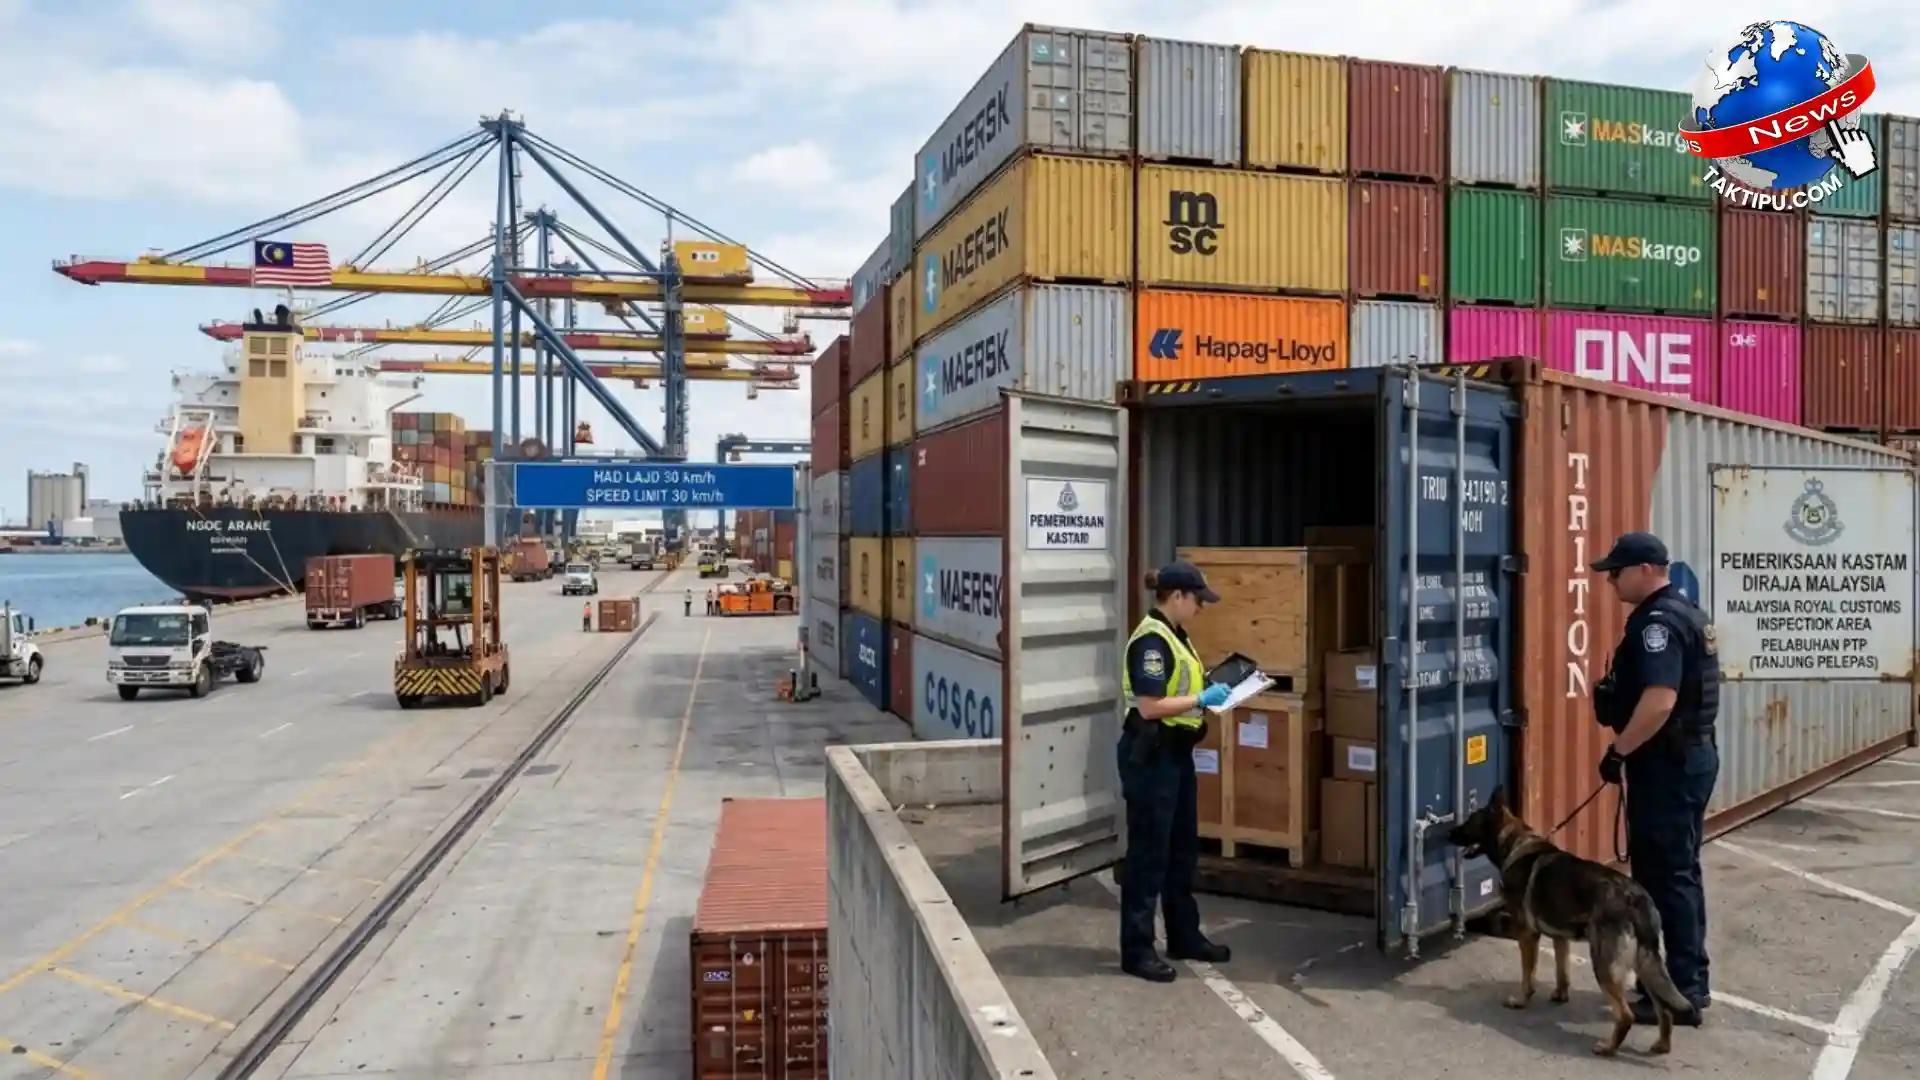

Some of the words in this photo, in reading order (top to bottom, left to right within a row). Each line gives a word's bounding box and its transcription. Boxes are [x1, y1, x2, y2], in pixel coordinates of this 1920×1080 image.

[941, 81, 1010, 182] MAERSK
[1592, 117, 1688, 153] MASkarg
[942, 206, 1009, 291] MAERSK
[1592, 234, 1701, 266] MASkargo
[942, 328, 1009, 398] MAERSK
[1196, 335, 1336, 363] Hapag-Lloyd
[1575, 328, 1692, 385] ONE
[585, 488, 631, 503] SPEED
[671, 489, 688, 503] 30
[1030, 513, 1105, 529] PEMERIKSAAN
[1720, 552, 1837, 570] PEMERIKSAAN
[1841, 553, 1908, 570] KASTAM
[1566, 453, 1590, 698] TRITON
[1743, 574, 1802, 592] DIRAJA
[1805, 575, 1886, 592] MALAYSIA
[1726, 600, 1791, 614] MALAYSIA
[1793, 600, 1836, 614] ROYAL
[1839, 600, 1902, 614] CUSTOMS
[1835, 617, 1873, 632] AREA
[1761, 637, 1841, 652] PELABUHAN
[1842, 638, 1868, 652] PTP
[1749, 655, 1815, 670] (TANJUNG
[1817, 655, 1879, 670] PELEPAS)
[925, 671, 994, 738] COSCO
